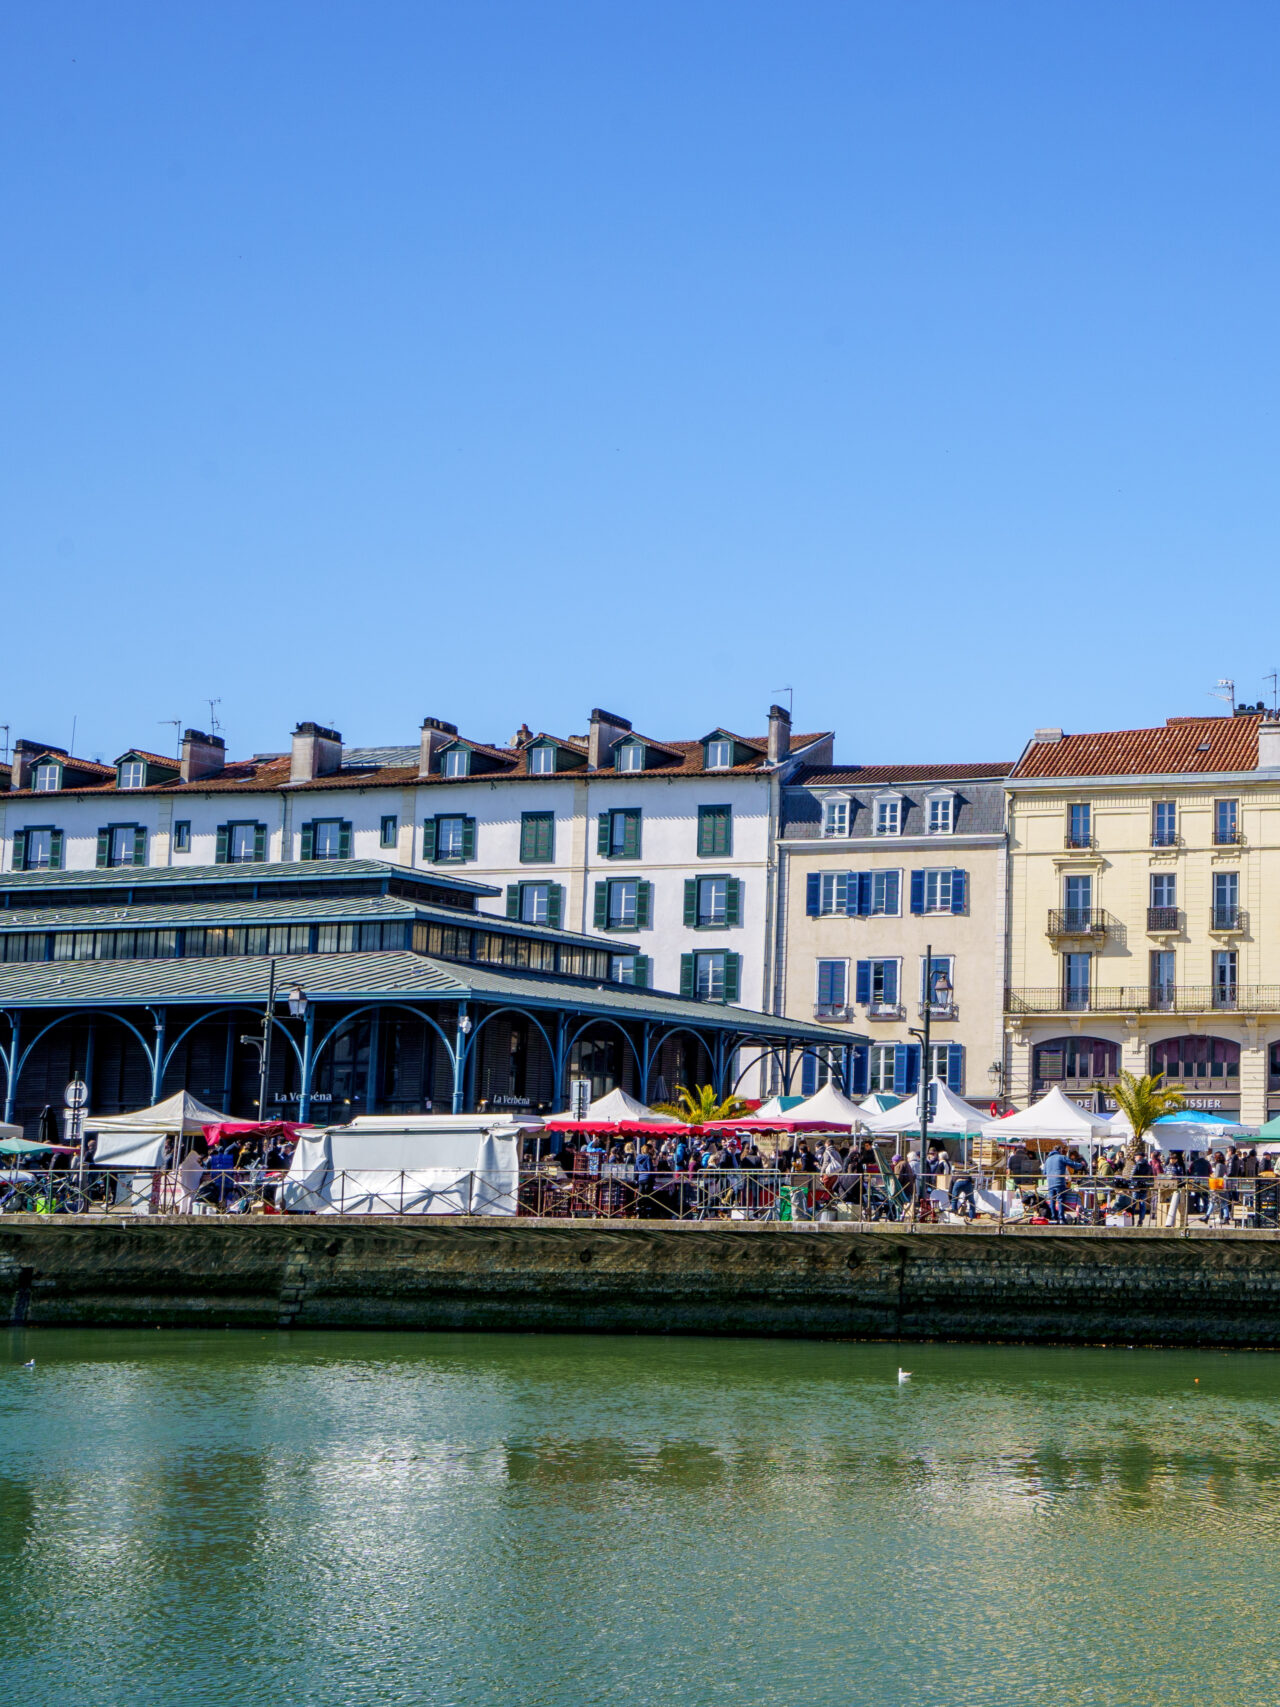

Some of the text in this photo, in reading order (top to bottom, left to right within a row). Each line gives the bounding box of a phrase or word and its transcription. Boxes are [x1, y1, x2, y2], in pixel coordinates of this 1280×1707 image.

[274, 1091, 332, 1102] La Veéna
[493, 1094, 502, 1104] La
[1077, 1099, 1091, 1108] DE
[1165, 1099, 1221, 1109] PAISSIER
